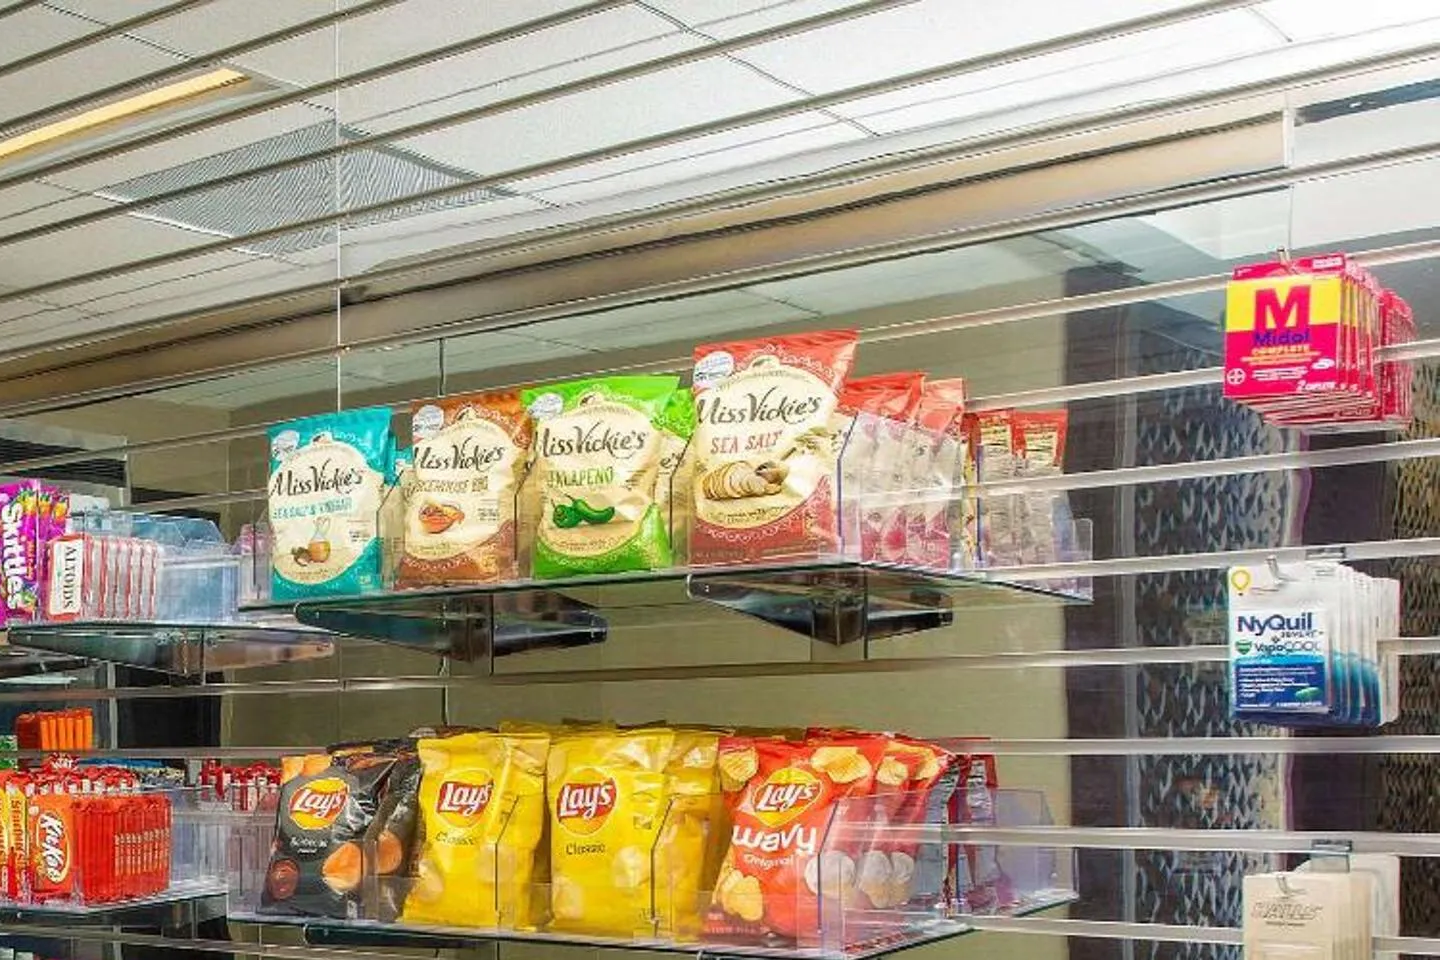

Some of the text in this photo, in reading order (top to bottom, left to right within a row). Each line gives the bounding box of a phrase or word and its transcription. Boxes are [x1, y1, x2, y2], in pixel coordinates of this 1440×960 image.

[1253, 328, 1309, 346] Midol
[746, 386, 822, 425] Vickie's
[574, 420, 649, 459] Vickie's
[711, 430, 782, 455] SEA SALT
[269, 458, 364, 497] Miss Vickie's
[0, 501, 25, 610] Skittles
[63, 545, 78, 610] ALTOIDS
[1237, 612, 1313, 636] NyQuil
[293, 787, 344, 818] Lay's
[439, 783, 494, 816] Lay's
[558, 781, 613, 820] Lay's
[756, 782, 816, 812] Lay's
[732, 824, 818, 856] wavy
[744, 852, 795, 869] Original
